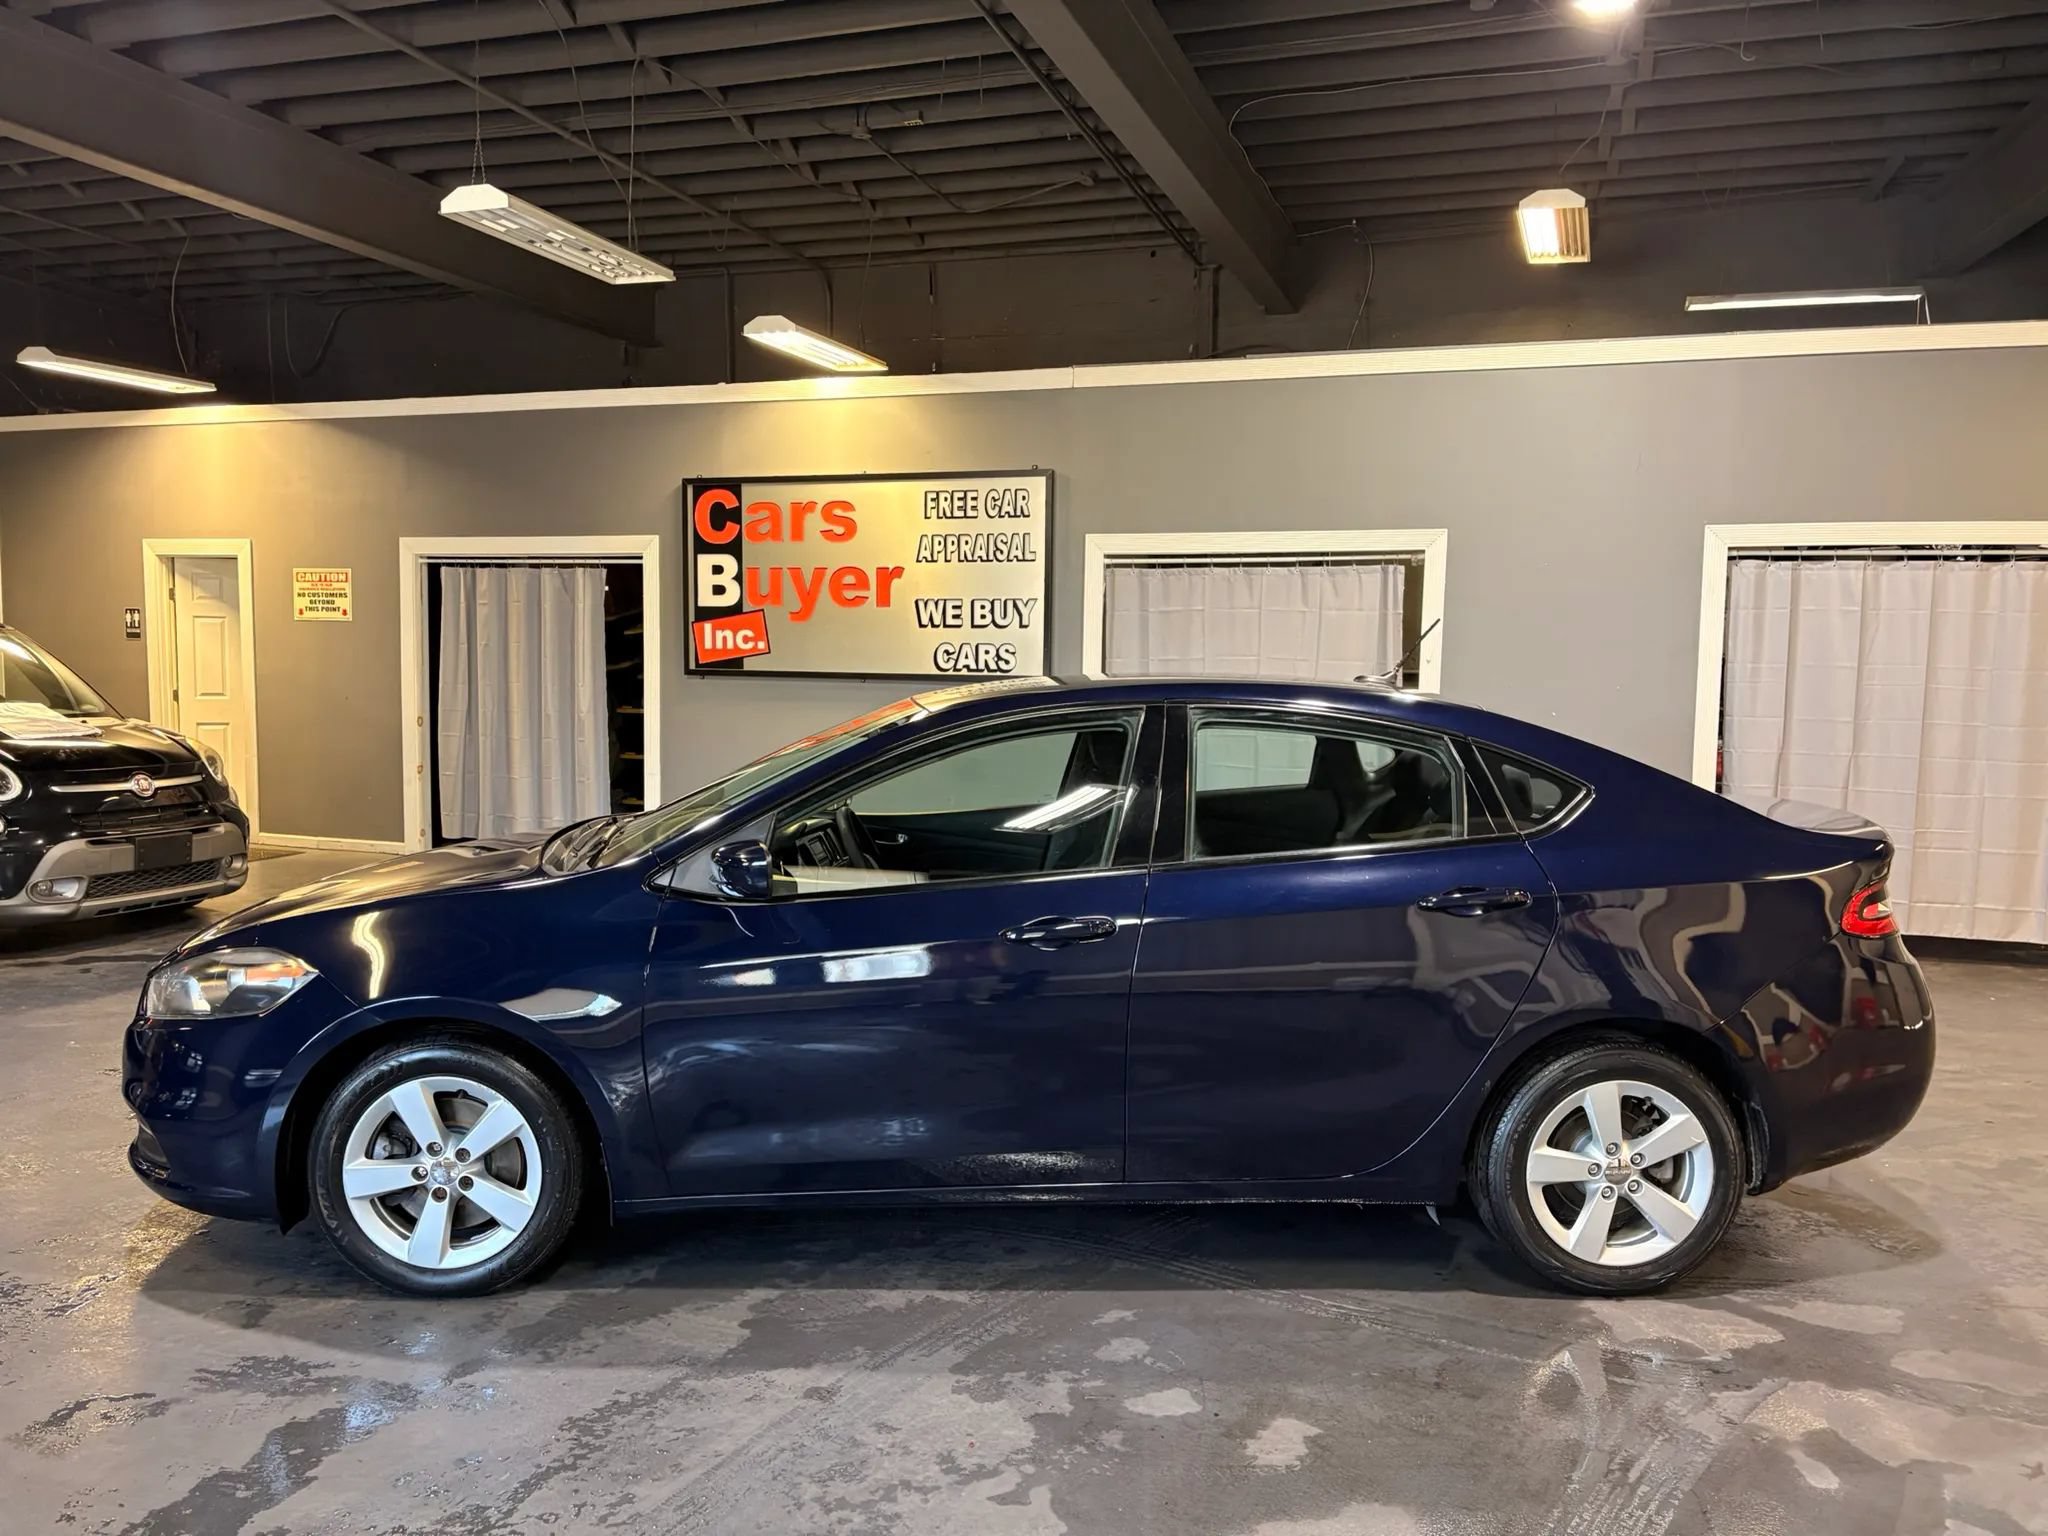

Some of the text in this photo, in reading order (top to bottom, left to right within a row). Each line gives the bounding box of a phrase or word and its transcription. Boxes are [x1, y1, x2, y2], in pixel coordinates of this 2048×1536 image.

[694, 489, 858, 545] Cars
[924, 488, 1031, 519] FREE CAR
[916, 533, 1036, 563] APPRAISAL
[297, 573, 347, 582] CAUTION
[697, 553, 905, 623] Buyer
[915, 598, 1038, 628] WE BUY
[703, 621, 766, 651] Inc.
[933, 642, 1017, 672] CARS
